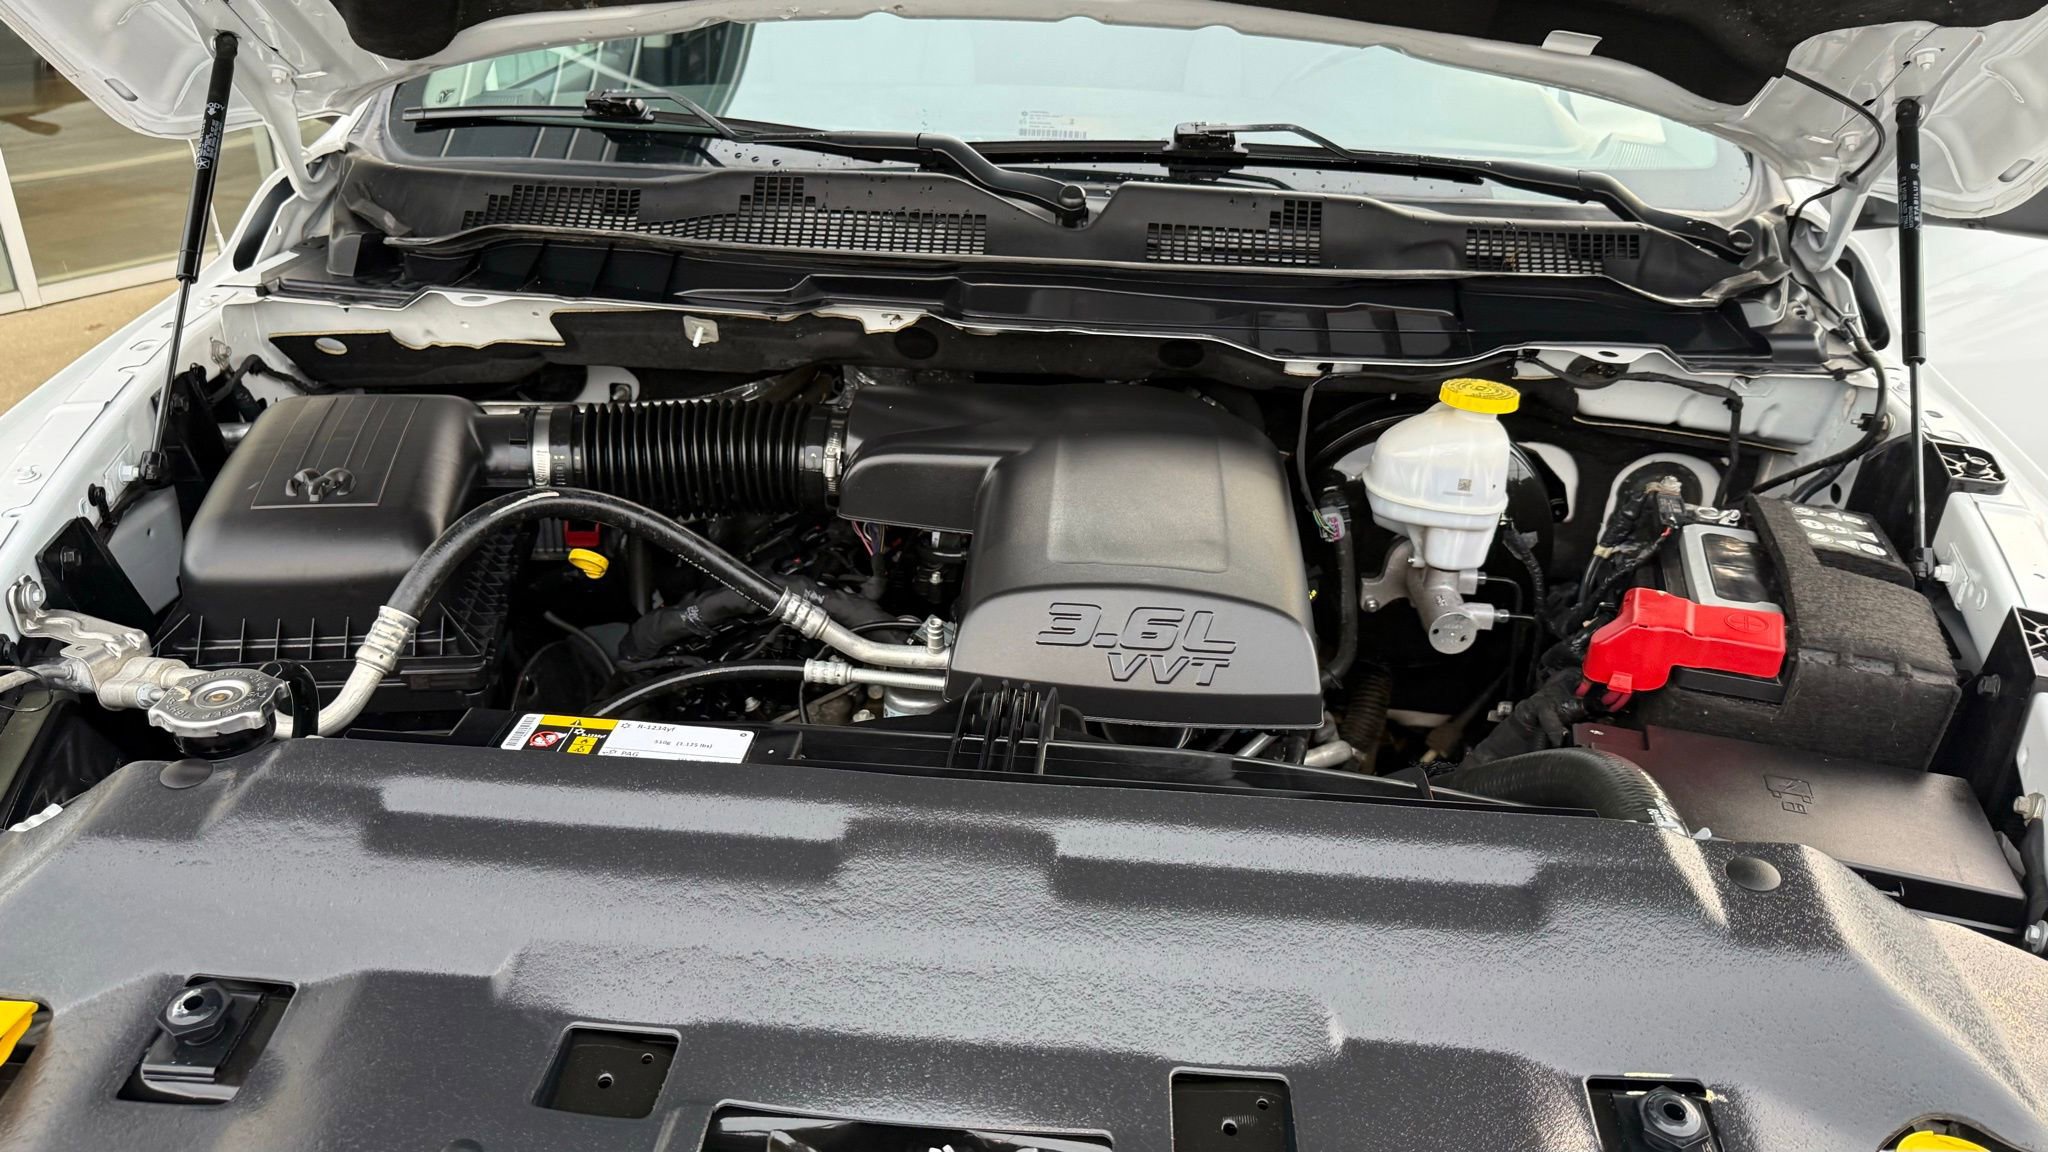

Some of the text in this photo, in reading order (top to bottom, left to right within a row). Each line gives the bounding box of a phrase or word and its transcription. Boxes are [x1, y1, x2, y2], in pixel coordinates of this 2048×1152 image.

[1035, 602, 1237, 654] 3.6L
[1107, 652, 1231, 687] VVT
[637, 723, 675, 733] R-1234yf
